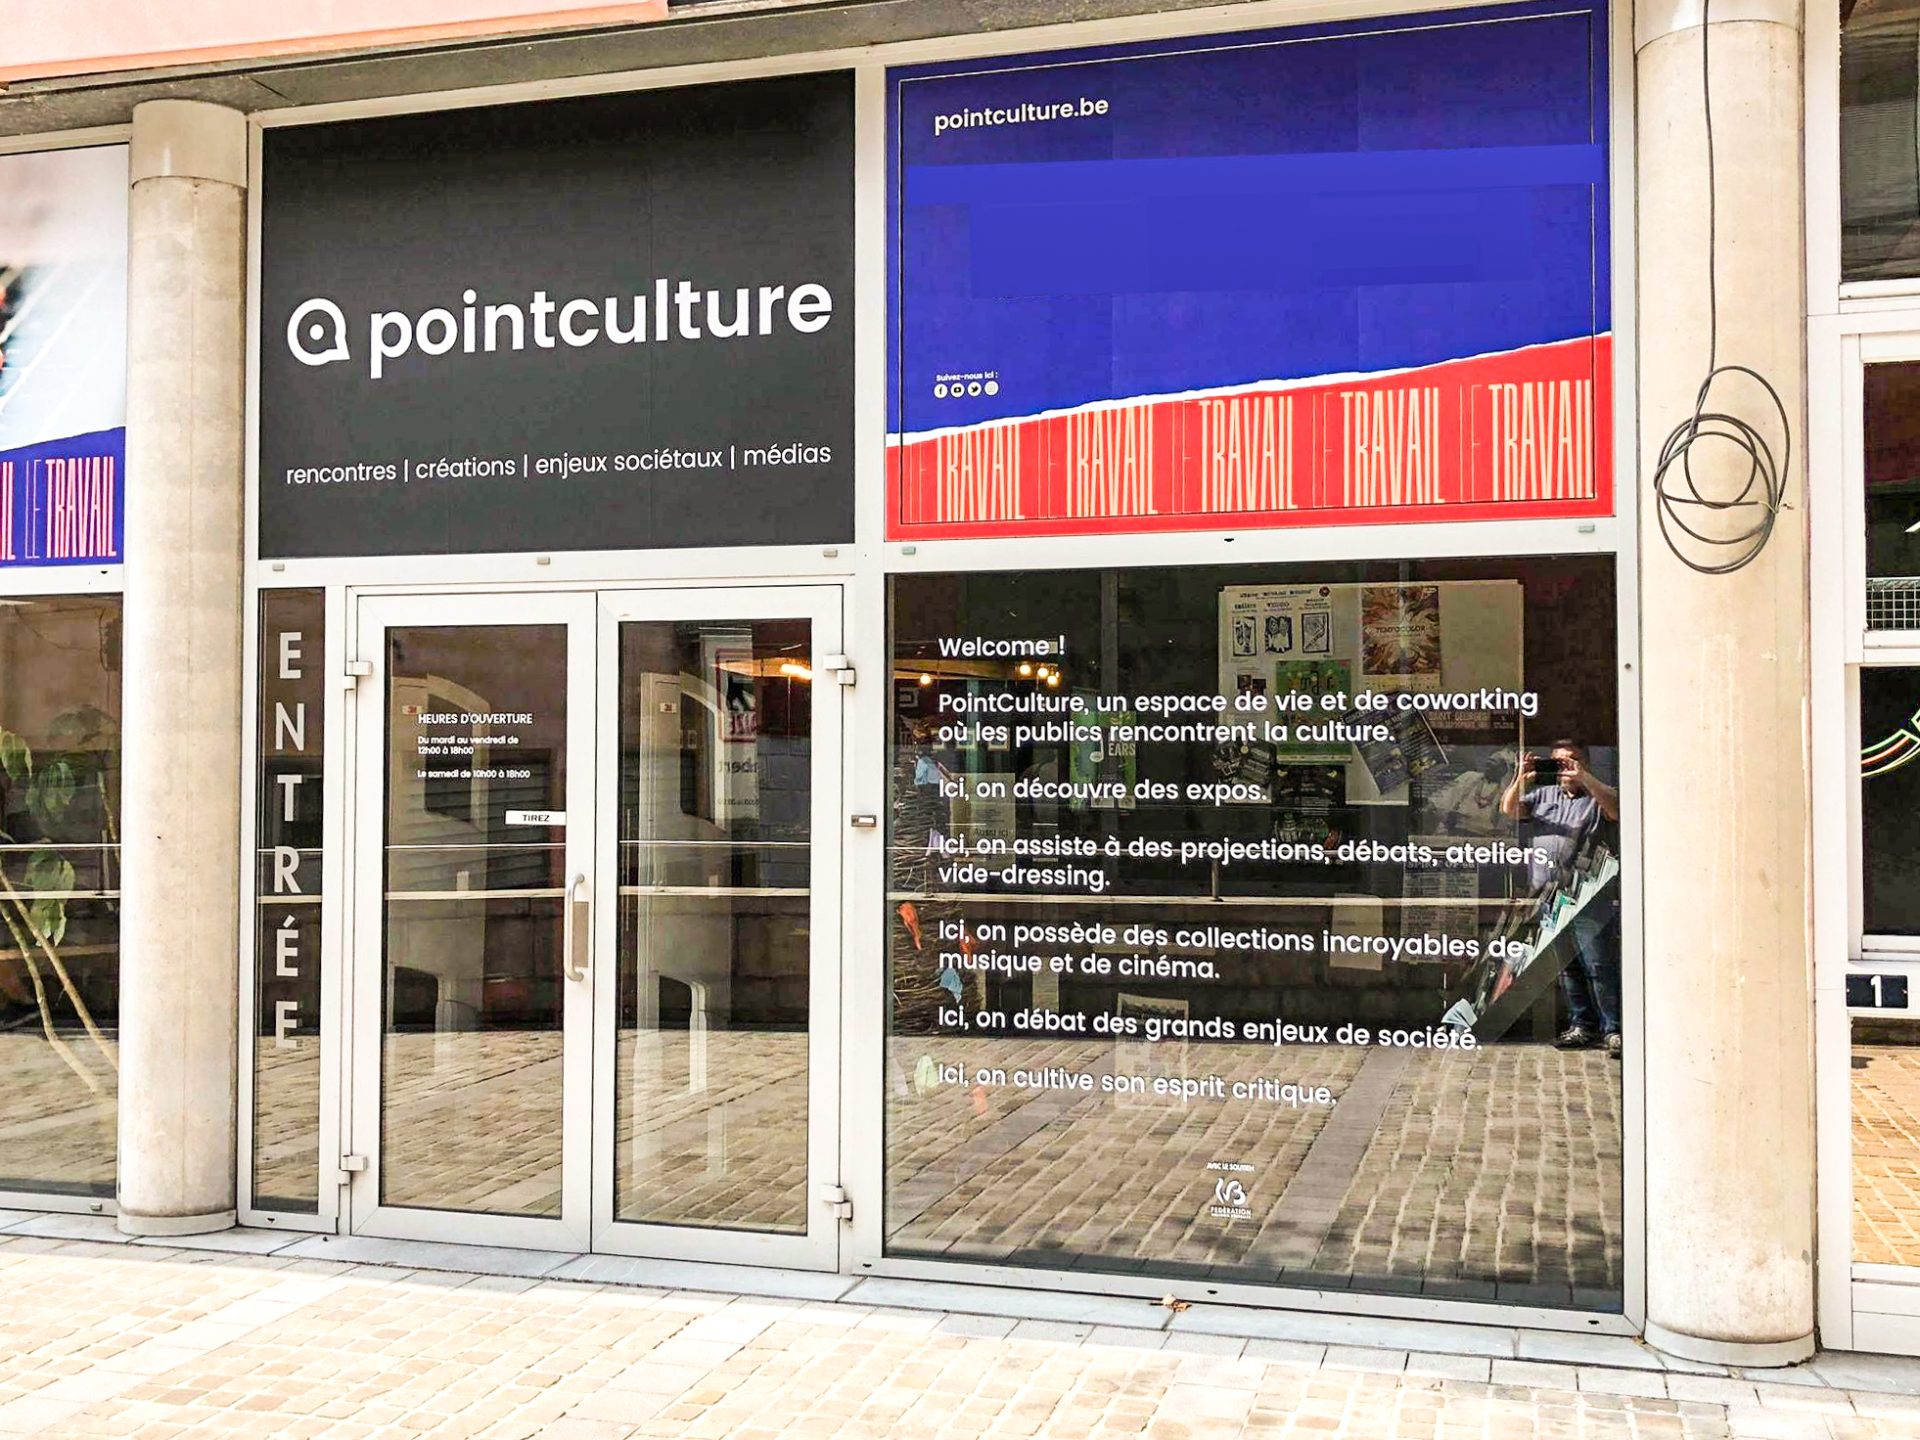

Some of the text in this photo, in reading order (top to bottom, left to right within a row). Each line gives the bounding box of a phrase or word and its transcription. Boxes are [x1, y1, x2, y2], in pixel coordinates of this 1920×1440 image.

[934, 97, 1109, 136] pointculture.be
[369, 277, 834, 380] pointculture
[936, 373, 983, 382] Suivez-nous
[286, 461, 397, 485] rencontres
[415, 455, 516, 481] créations
[535, 451, 608, 480] enjeux
[614, 446, 723, 474] sociétaux
[743, 441, 832, 467] médias
[1067, 403, 1158, 518] TRAVAIL
[1198, 394, 1299, 513] TRAVAIL
[1340, 387, 1446, 508] TRAVAIL
[1488, 378, 1598, 502] TRAVAIL
[45, 456, 117, 559] TRAVAIL
[938, 636, 1050, 657] Welcome
[939, 687, 1539, 718] PointCulture, un espace de vie et de coworking
[418, 713, 533, 725] HEURES D'OUVERTURE
[938, 720, 1395, 748] où les publics rencontrent la culture.
[417, 736, 429, 744] Du
[430, 735, 456, 744] mardi
[470, 735, 506, 744] vendredi
[507, 736, 519, 744] de
[450, 746, 475, 755] 18h00
[1108, 742, 1136, 757] EARS
[417, 770, 427, 778] Le
[428, 769, 459, 778] samedi
[460, 770, 472, 778] de
[473, 770, 497, 778] 10h00
[506, 770, 531, 778] 18h00
[939, 777, 969, 801] Ici,
[976, 782, 1006, 798] on
[1013, 777, 1127, 799] découvre
[1134, 779, 1179, 799] des
[1186, 784, 1267, 807] expos.
[522, 814, 550, 823] TIREZ
[273, 631, 306, 1050] ENTRÉE
[939, 833, 1555, 868] Ici, on assiste à des projections, débats, ateliers,
[938, 862, 1110, 892] vide-dressing.
[939, 919, 1524, 961] Ici, on possède des collections incroyables de
[939, 949, 1220, 978] musique et de cinéma.
[1870, 975, 1882, 1007] 1
[939, 1005, 969, 1030] Ici,
[976, 1011, 1006, 1028] on
[1013, 1008, 1086, 1032] débat
[1093, 1011, 1137, 1034] des
[1145, 1016, 1235, 1042] grands
[1243, 1018, 1329, 1046] enjeux
[1336, 1023, 1370, 1045] de
[1378, 1026, 1483, 1050] société.
[939, 1063, 1336, 1108] Ici, on cultive son esprit critique.
